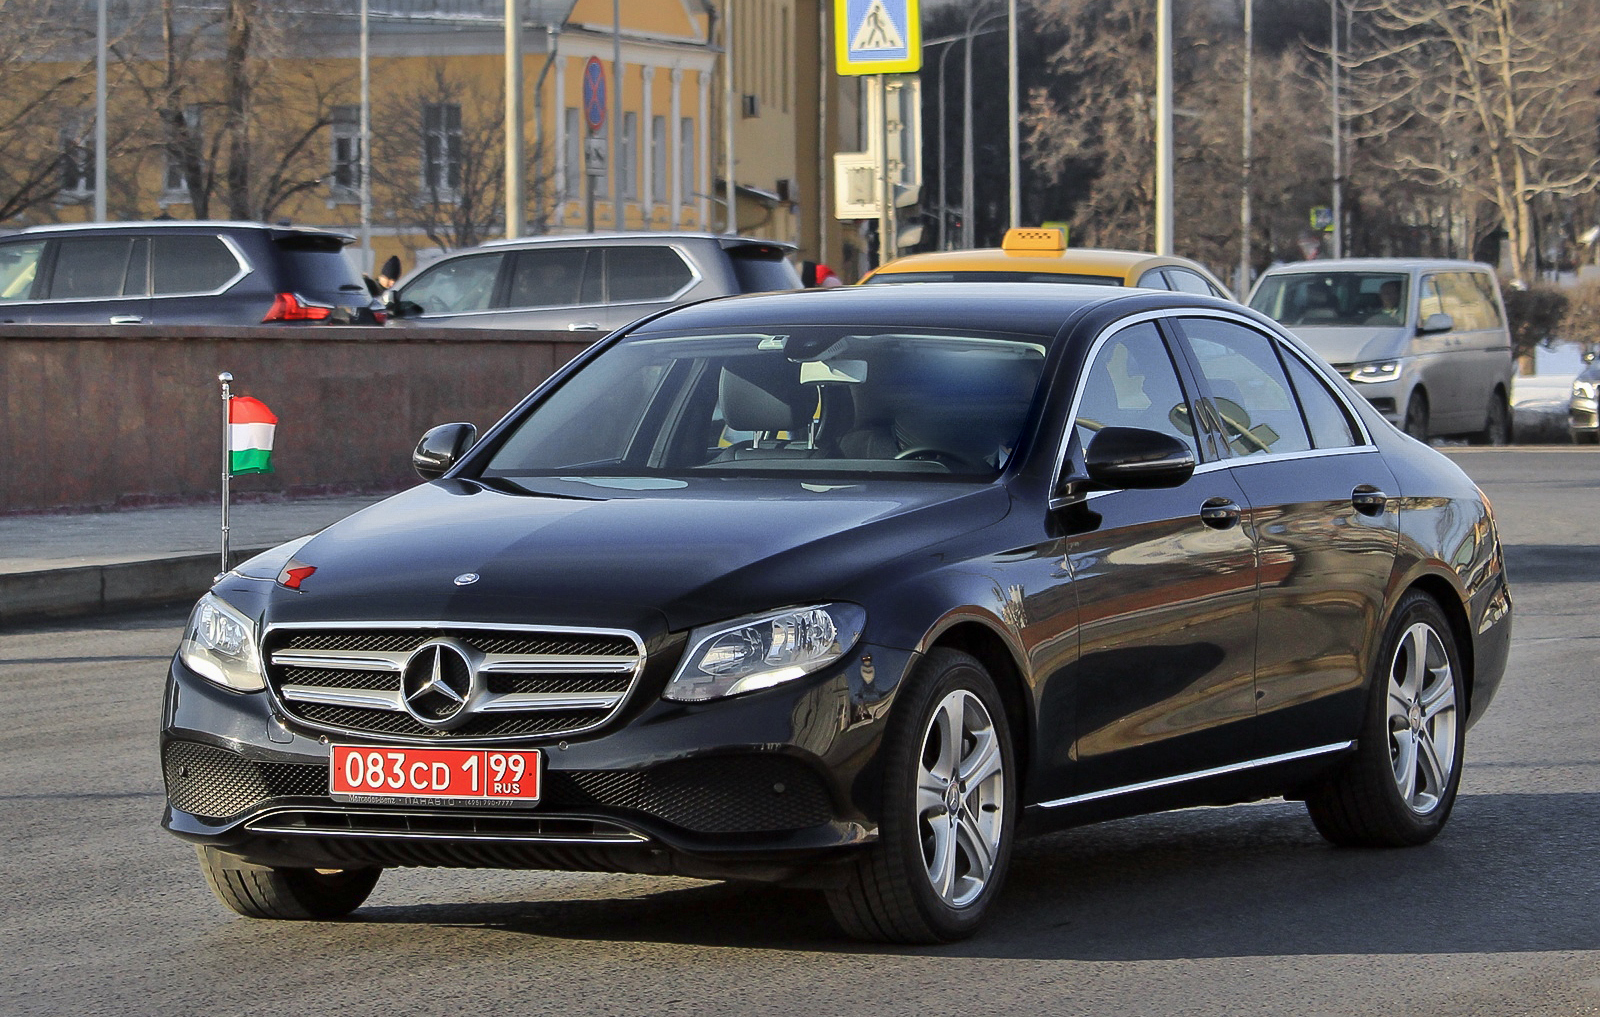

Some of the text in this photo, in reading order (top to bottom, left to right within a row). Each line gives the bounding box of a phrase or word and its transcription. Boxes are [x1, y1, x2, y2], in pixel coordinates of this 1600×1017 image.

[345, 751, 479, 792] 083CD 1
[490, 754, 526, 782] 99
[494, 782, 521, 794] RUS
